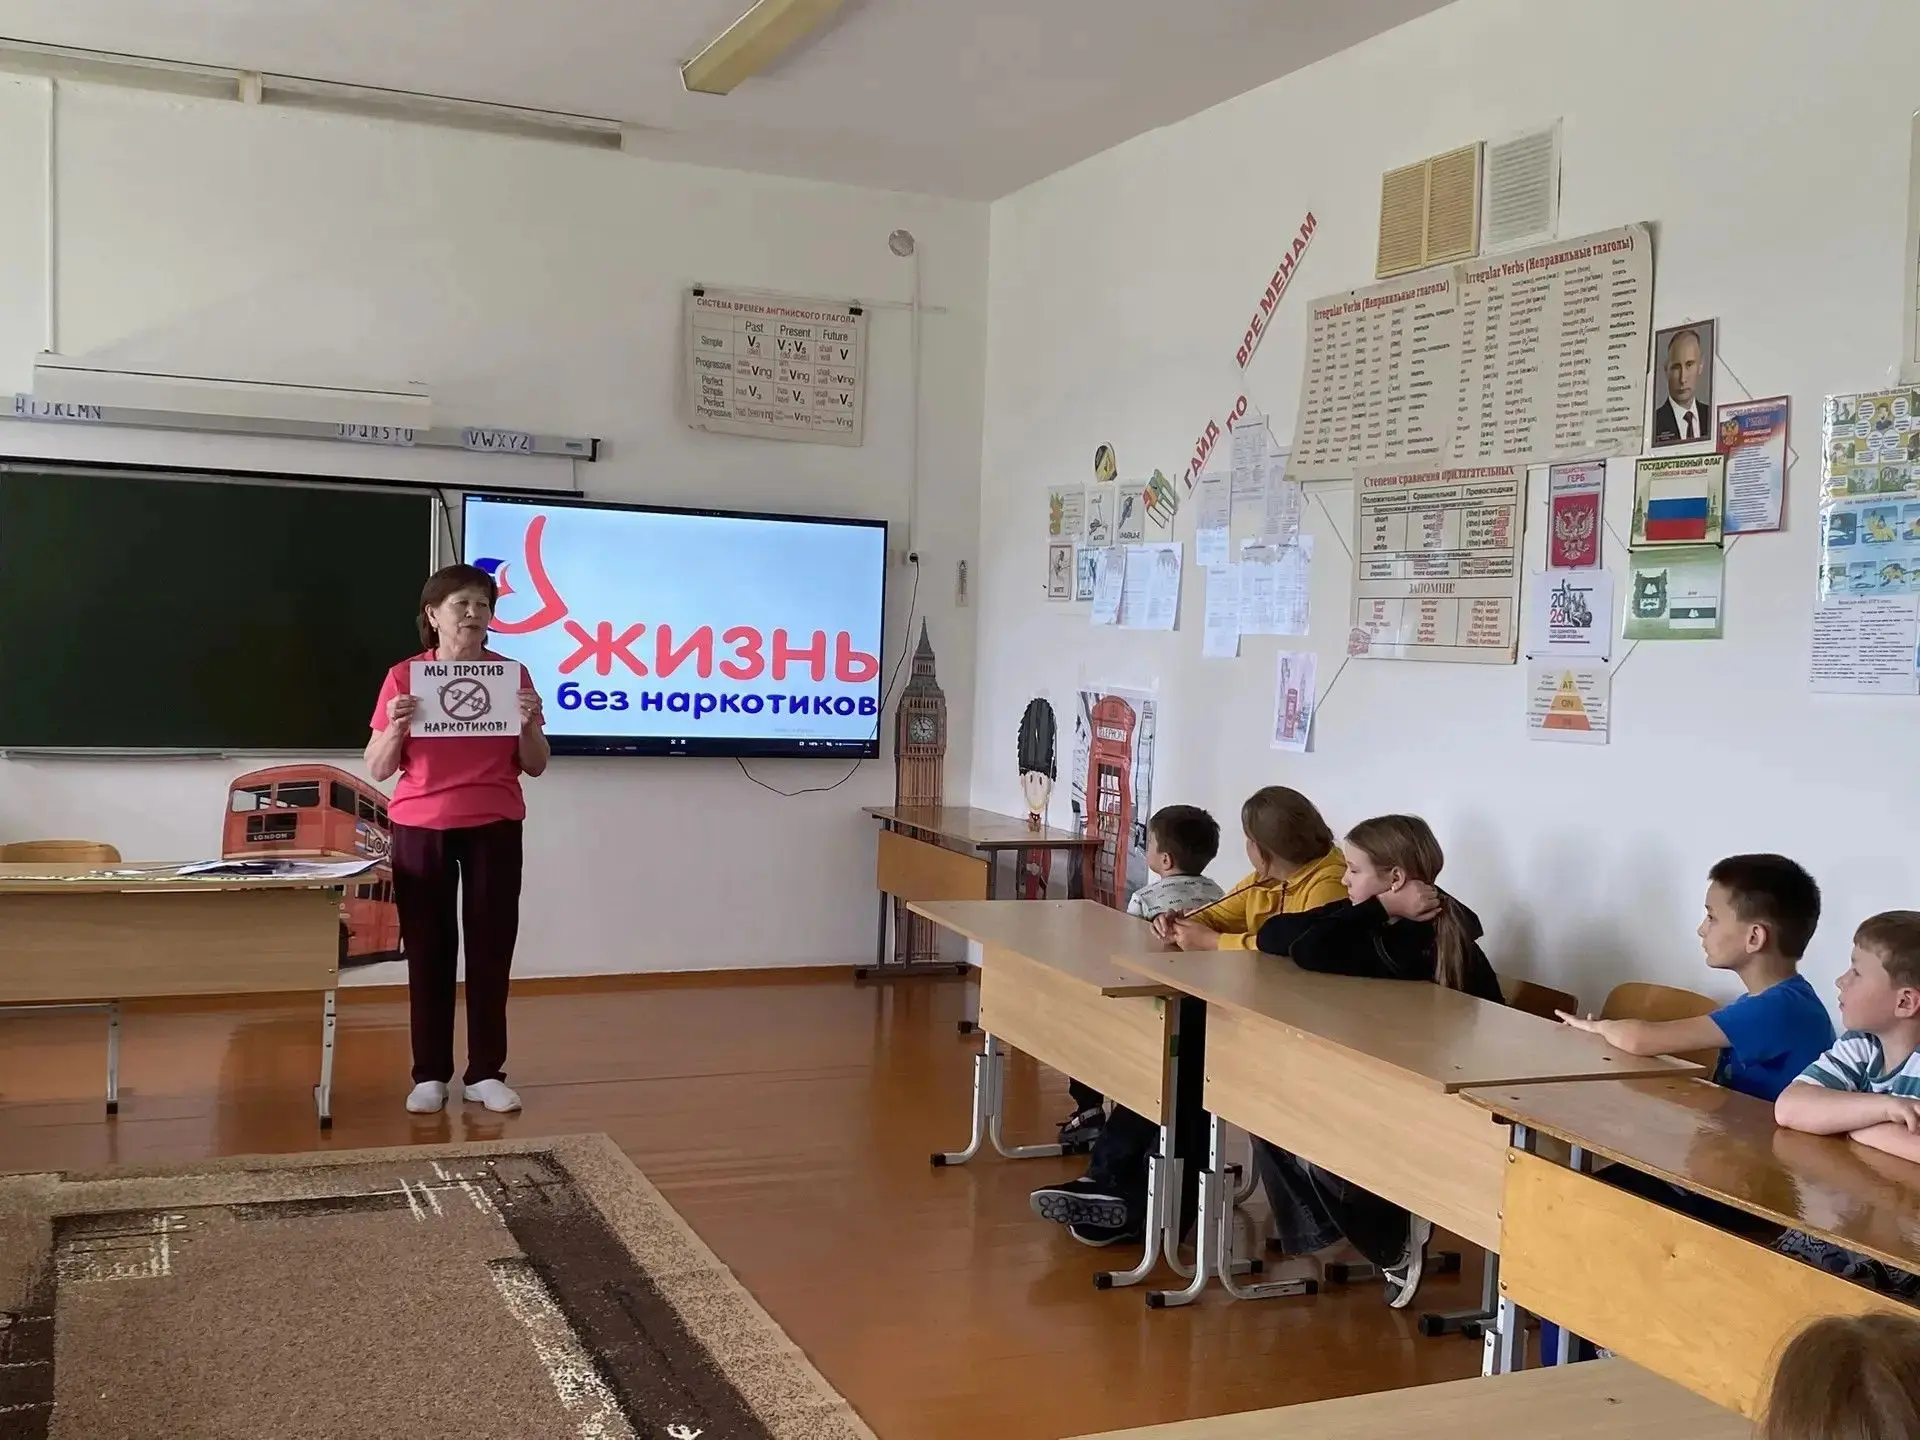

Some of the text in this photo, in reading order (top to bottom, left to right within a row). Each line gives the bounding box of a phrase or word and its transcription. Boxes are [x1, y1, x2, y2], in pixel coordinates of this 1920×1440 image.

[1465, 265, 1501, 285] Irregular
[1502, 260, 1525, 277] Verbs
[697, 298, 856, 324] СИСТЕМА ВРЕМЕН АНГЛИЙСКОГО ГЛАГОЛА
[1313, 303, 1343, 321] Irregular
[1343, 299, 1361, 313] Verbs
[745, 321, 848, 342] Past Present Future
[701, 336, 723, 347] Simple
[840, 349, 849, 360] V
[696, 356, 732, 371] Progressive
[751, 365, 773, 379] Ving
[789, 369, 810, 383] Ving
[702, 375, 723, 386] Perfect
[702, 385, 723, 396] Simple
[703, 396, 725, 409] Perfect
[697, 405, 732, 419] Progressive
[1226, 395, 1247, 434] ПО
[468, 431, 529, 450] VWXYZ
[1639, 456, 1722, 471] ГОСУДАРСТВЕННЫЙ ФЛАГ
[1364, 466, 1514, 488] Степени сравнения прилагательных
[1567, 474, 1586, 483] ГЕРБ
[1551, 593, 1565, 608] 20
[1550, 608, 1565, 624] 26
[557, 620, 879, 683] жизнь
[424, 665, 504, 677] МЫ ПРОТИВ
[1563, 681, 1574, 689] AT
[557, 682, 878, 720] без наркотиков
[1561, 699, 1574, 708] ON
[424, 721, 508, 733] НАРКОТИКОВ!
[253, 833, 289, 841] LONDON
